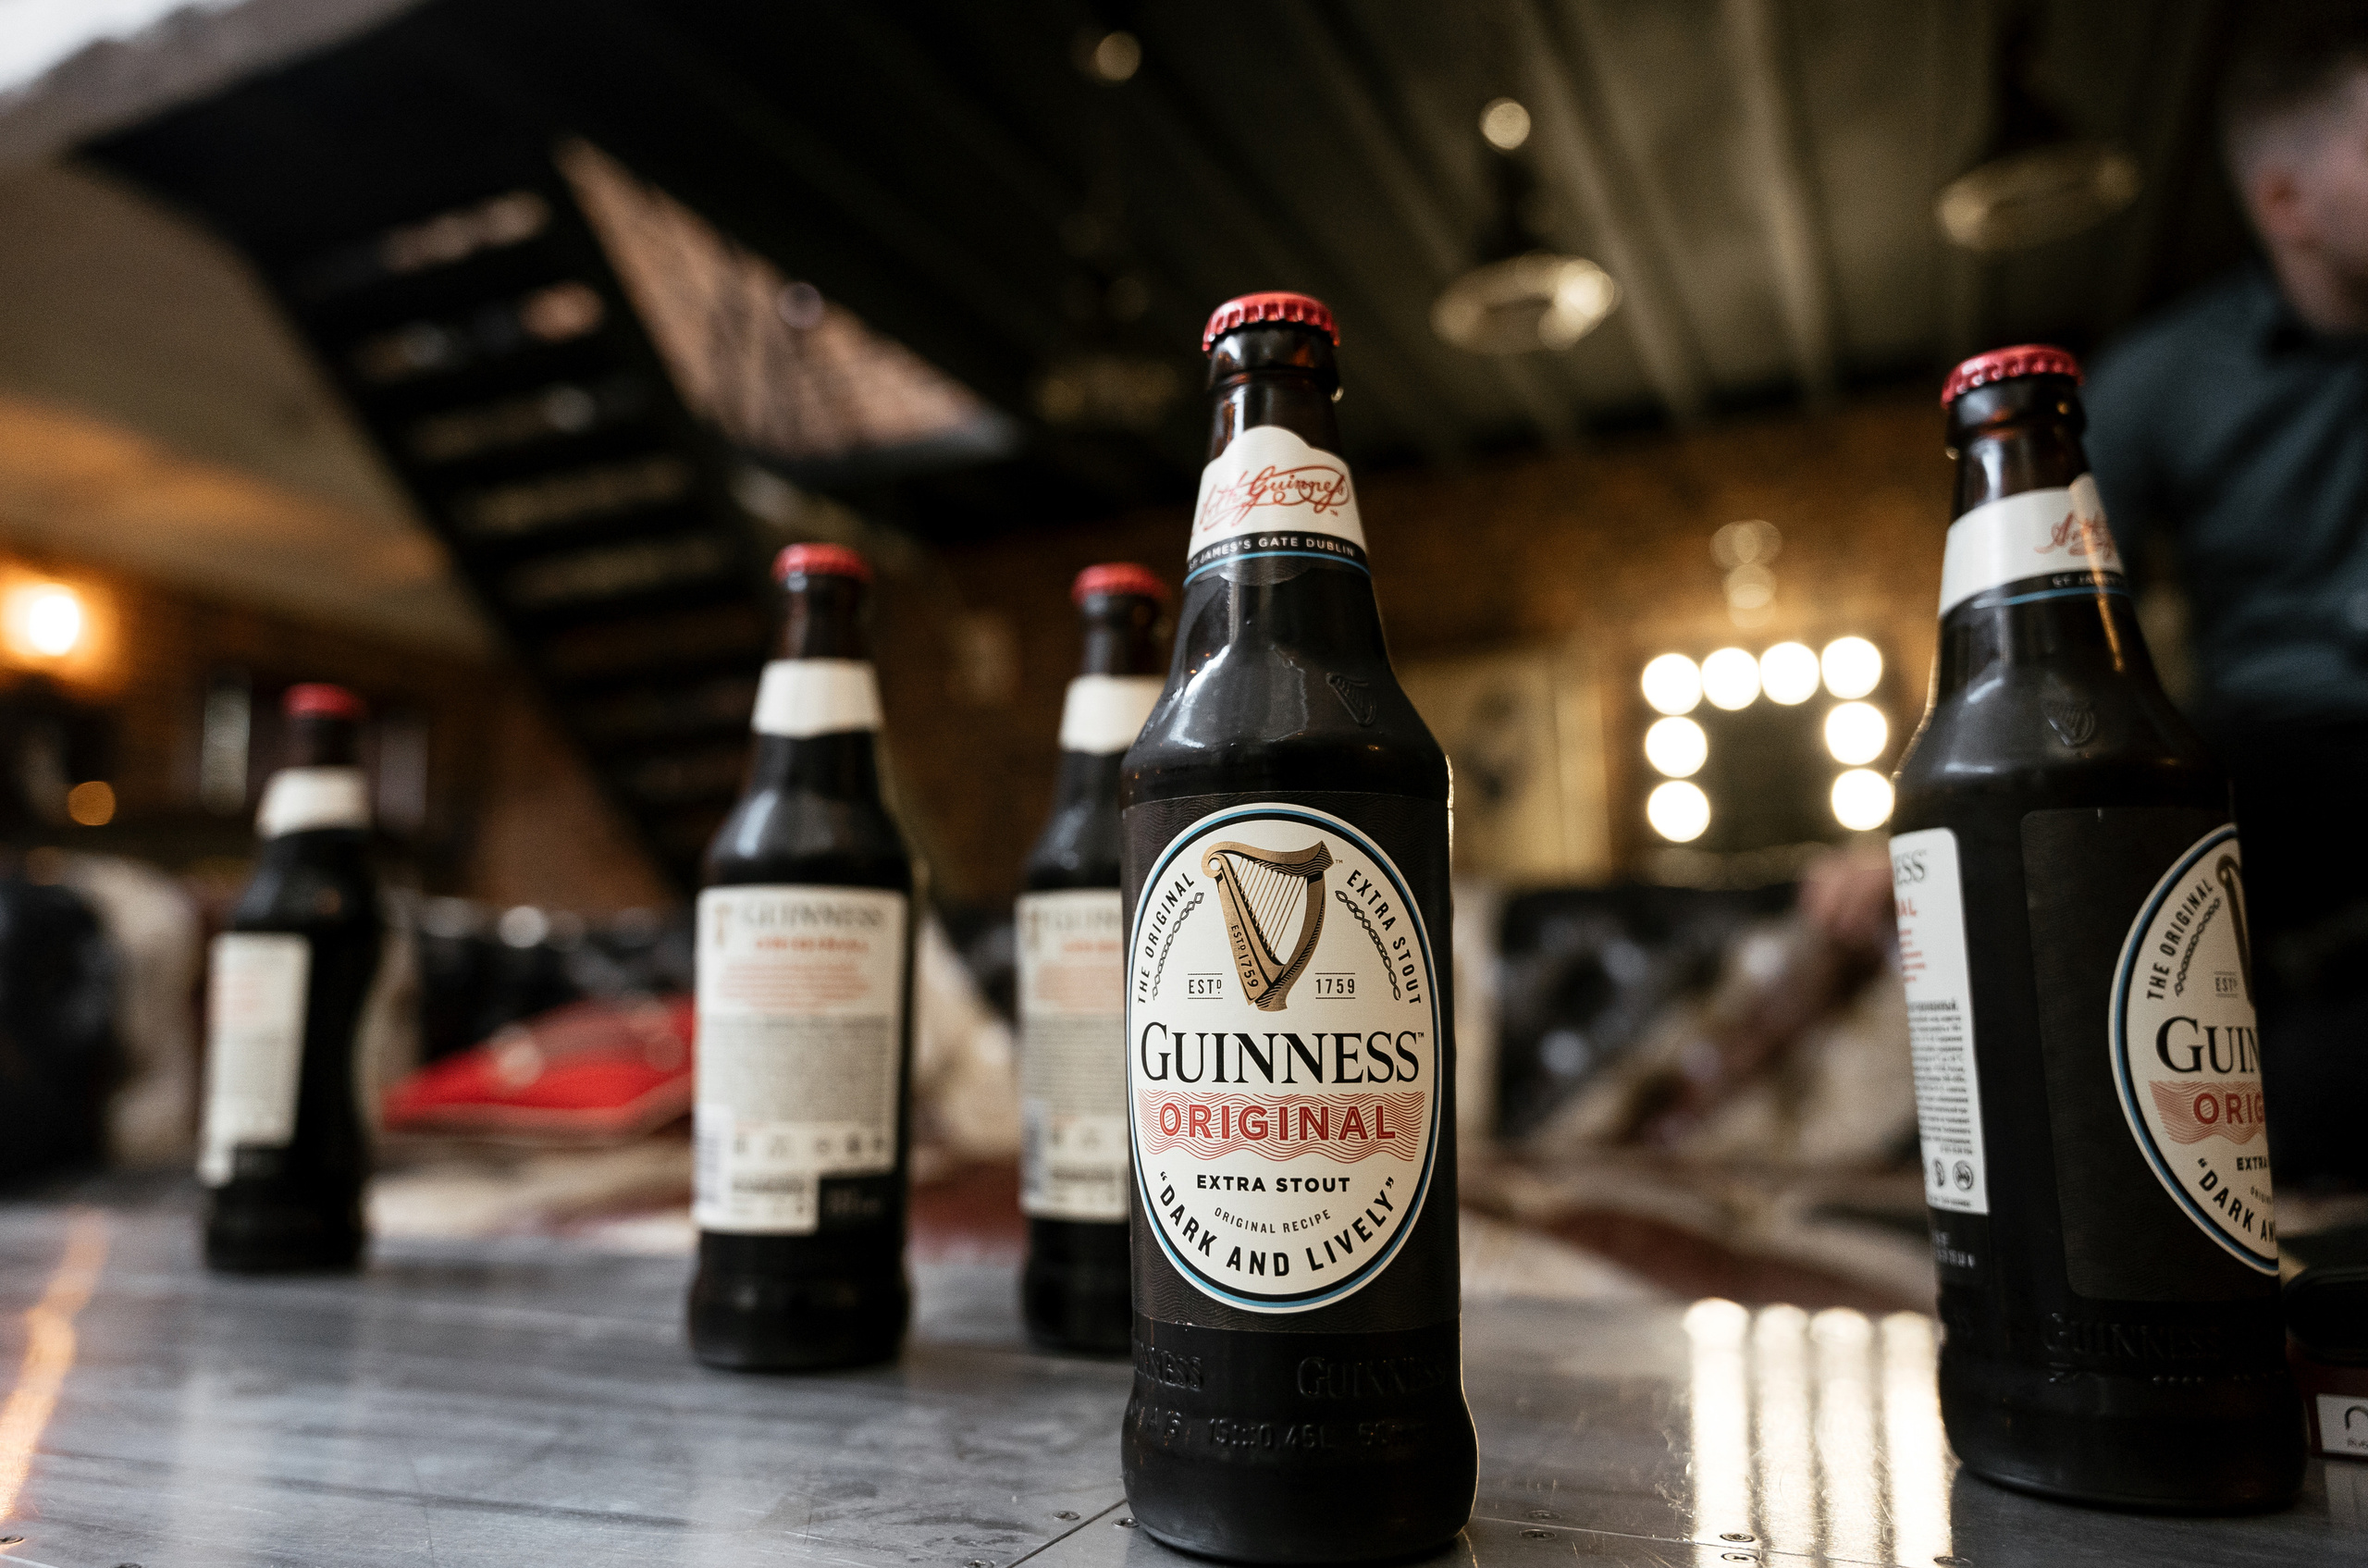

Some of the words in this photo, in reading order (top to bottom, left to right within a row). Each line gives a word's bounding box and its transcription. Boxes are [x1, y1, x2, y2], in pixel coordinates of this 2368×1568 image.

[1201, 539, 1252, 564] JAMES'S
[1258, 537, 1299, 548] GATE
[1306, 537, 1355, 557] DUBLIN
[1137, 966, 1151, 1005] THE
[1144, 872, 1196, 959] ORIGINAL
[1346, 869, 1398, 932] EXTRA
[1392, 936, 1423, 1005] STOUT
[2147, 961, 2170, 1000] THE
[2159, 879, 2214, 957] ORIGINAL
[1238, 954, 1259, 988] 1759
[1316, 978, 1356, 994] 1759
[1141, 1021, 1420, 1084] GUINNESS
[2155, 1016, 2261, 1074] GUIN
[1159, 1102, 1396, 1142] ORIGINAL
[2193, 1092, 2265, 1125] ORIG
[1196, 1174, 1266, 1192] EXTRA
[1276, 1177, 1350, 1193] STOUT
[1215, 1207, 1276, 1234] ORIGINAL
[1283, 1209, 1331, 1234] RECIPE
[2260, 1219, 2276, 1242] AN
[1226, 1246, 1289, 1277] AND
